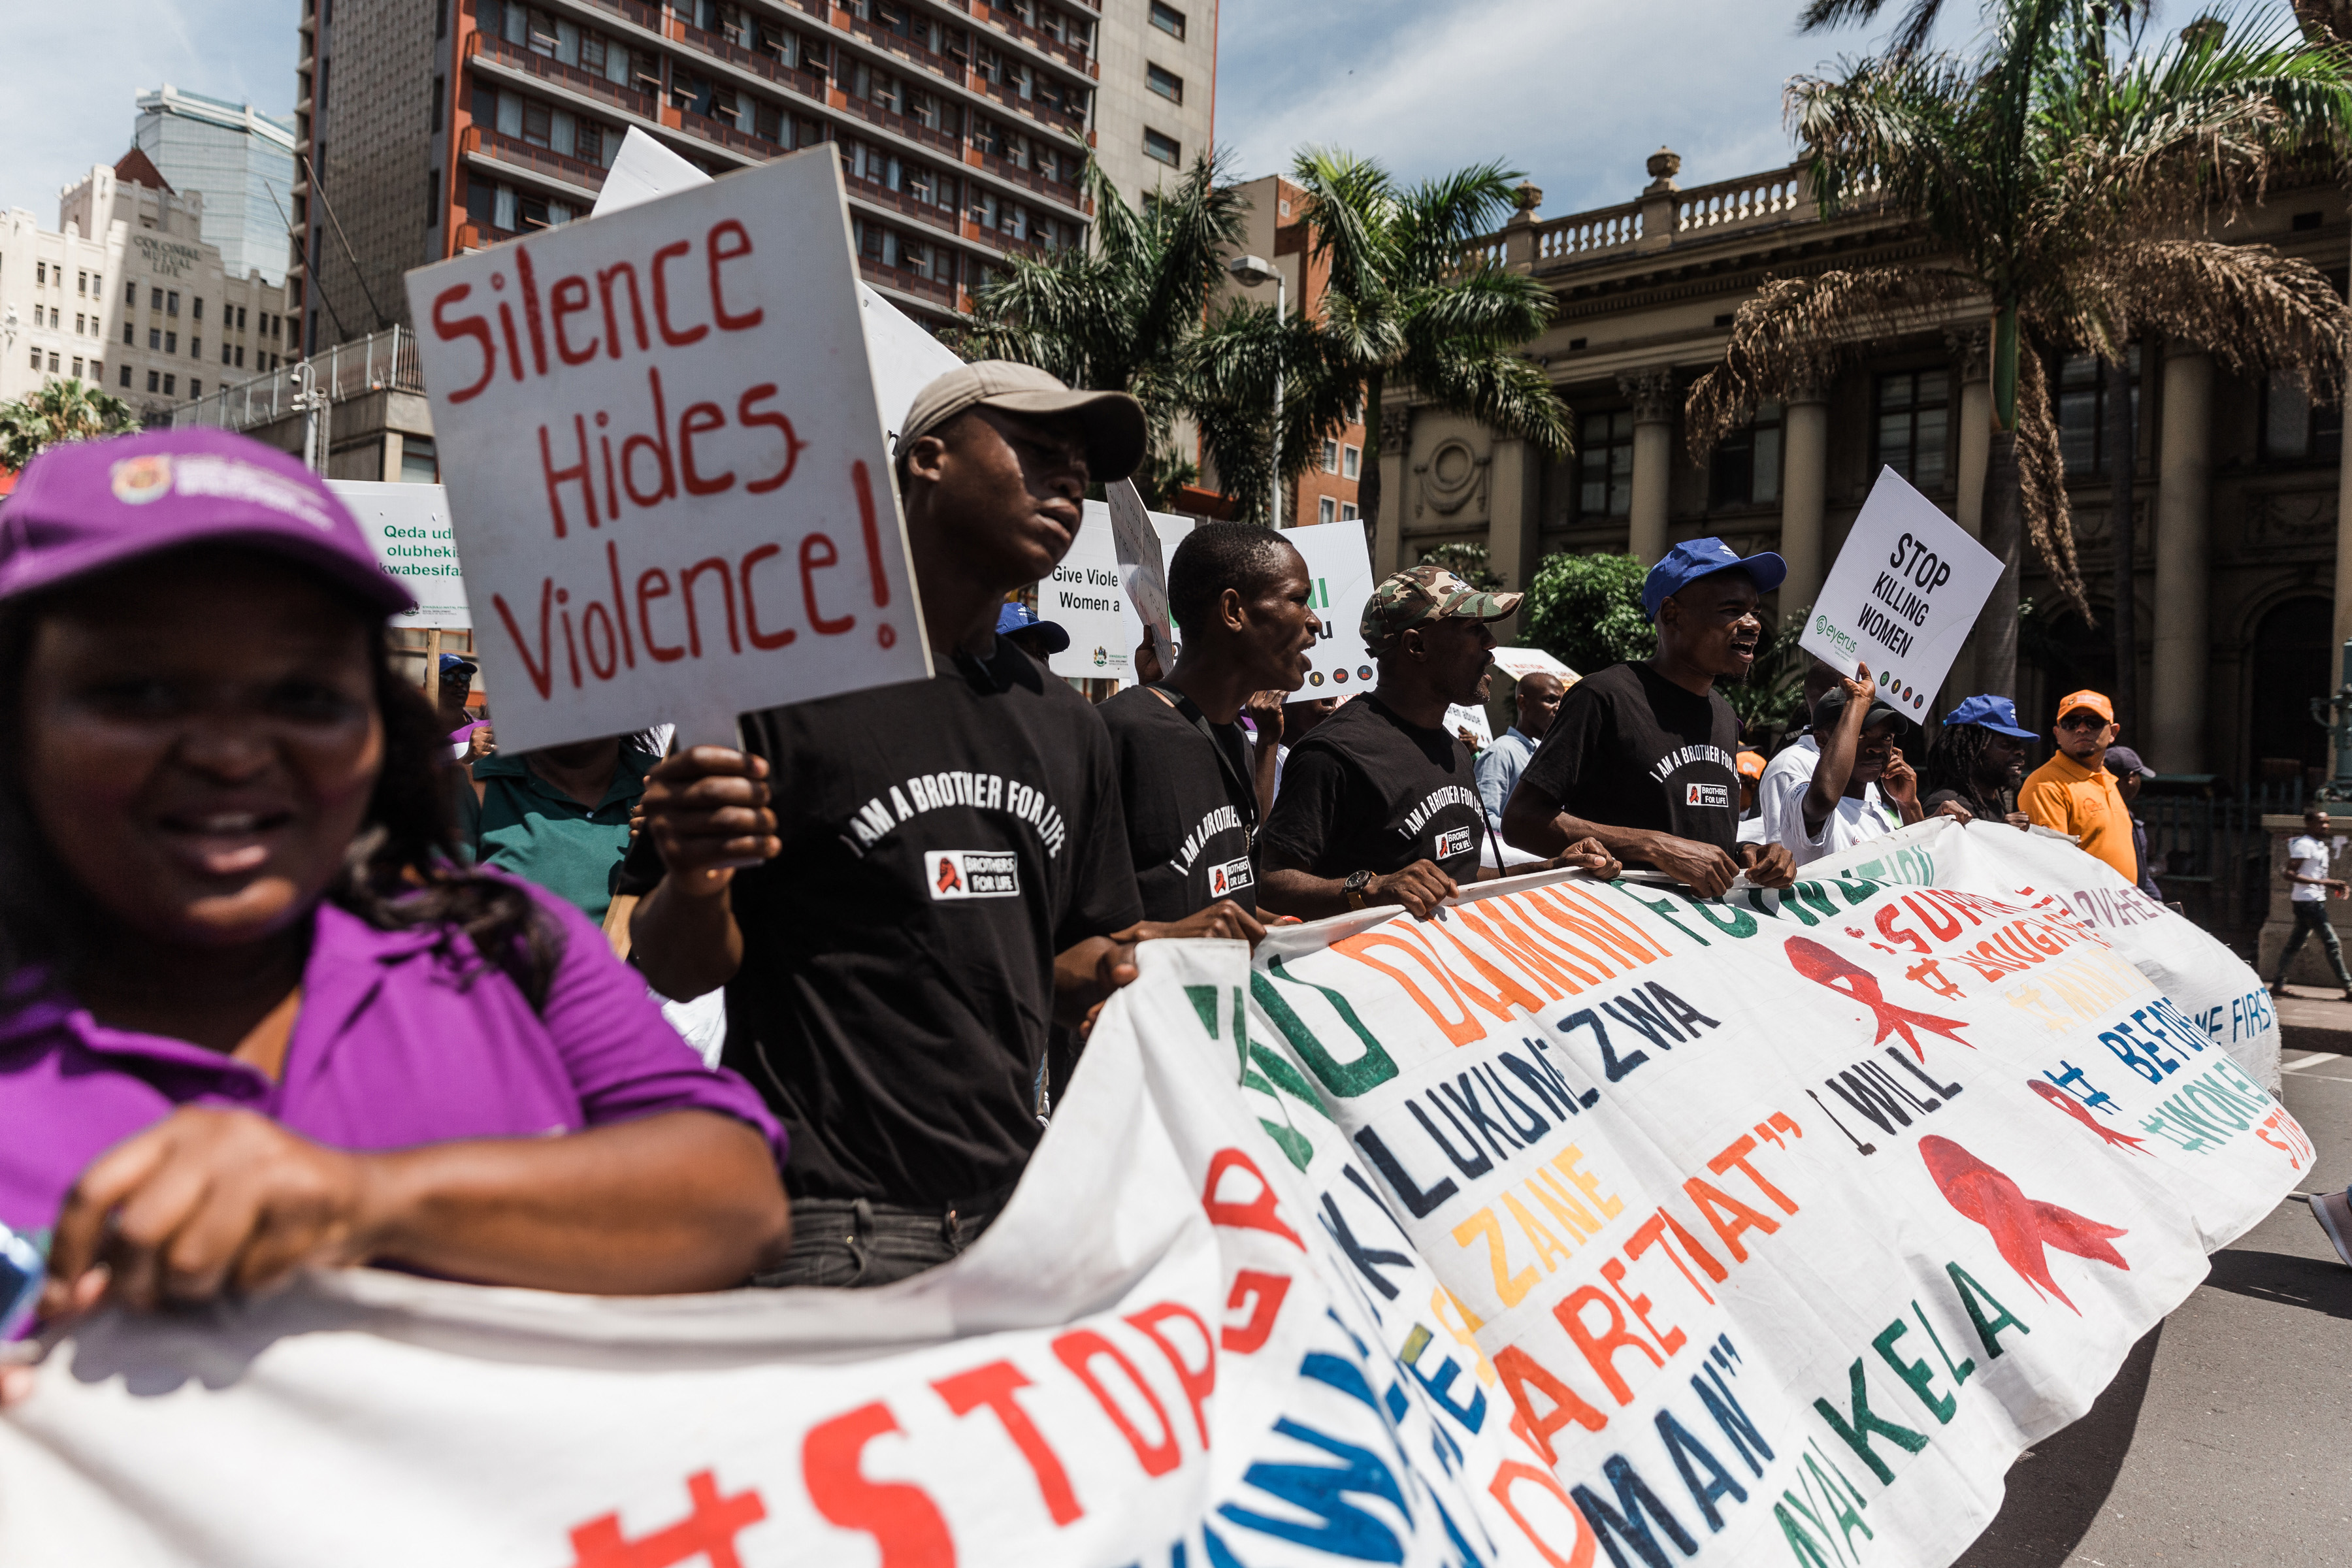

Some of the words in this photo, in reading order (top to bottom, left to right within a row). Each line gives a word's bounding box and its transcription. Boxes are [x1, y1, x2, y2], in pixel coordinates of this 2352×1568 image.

[133, 235, 201, 261] COLONIAL
[142, 249, 192, 270] MUTUAL
[153, 261, 180, 278] LIFE
[432, 219, 763, 404] Silence
[540, 367, 810, 538] Hides
[384, 525, 426, 538] Qeda
[1052, 565, 1083, 583] Give
[1087, 568, 1119, 587] Viole
[1890, 532, 1950, 595] STOP
[493, 459, 897, 700] Violence!
[1060, 591, 1109, 611] Women
[1113, 600, 1120, 612] a
[1872, 571, 1929, 627] KILLING
[1826, 625, 1857, 653] eyerus
[1857, 602, 1914, 658] WOMEN
[1649, 771, 1663, 783] I
[1657, 755, 1674, 779] AM
[1673, 751, 1682, 768] A
[1680, 744, 1720, 764] BROTHER
[1721, 749, 1733, 773] FOR
[889, 785, 915, 822] A
[907, 771, 1002, 813] BROTHER
[1006, 780, 1045, 826] FOR
[1426, 785, 1460, 814] BROTHER
[1460, 787, 1473, 808] FOR
[1701, 786, 1726, 796] BROTHERS
[1705, 795, 1716, 804] FOR
[849, 797, 896, 848] AM
[1404, 808, 1426, 836] AM
[1420, 801, 1432, 821] A
[1037, 804, 1066, 859] LIFE
[1398, 828, 1411, 840] I
[1448, 830, 1469, 843] BROTHERS
[838, 834, 864, 859] I
[1169, 859, 1188, 876] I
[1180, 834, 1200, 868] AM
[1196, 825, 1206, 849] A
[1452, 843, 1463, 852] FOR
[964, 856, 1015, 874] BROTHERS
[972, 874, 995, 892] FOR
[996, 875, 1013, 891] LIFE
[2232, 987, 2276, 1043] FIRST
[1825, 1047, 1963, 1135] WILL
